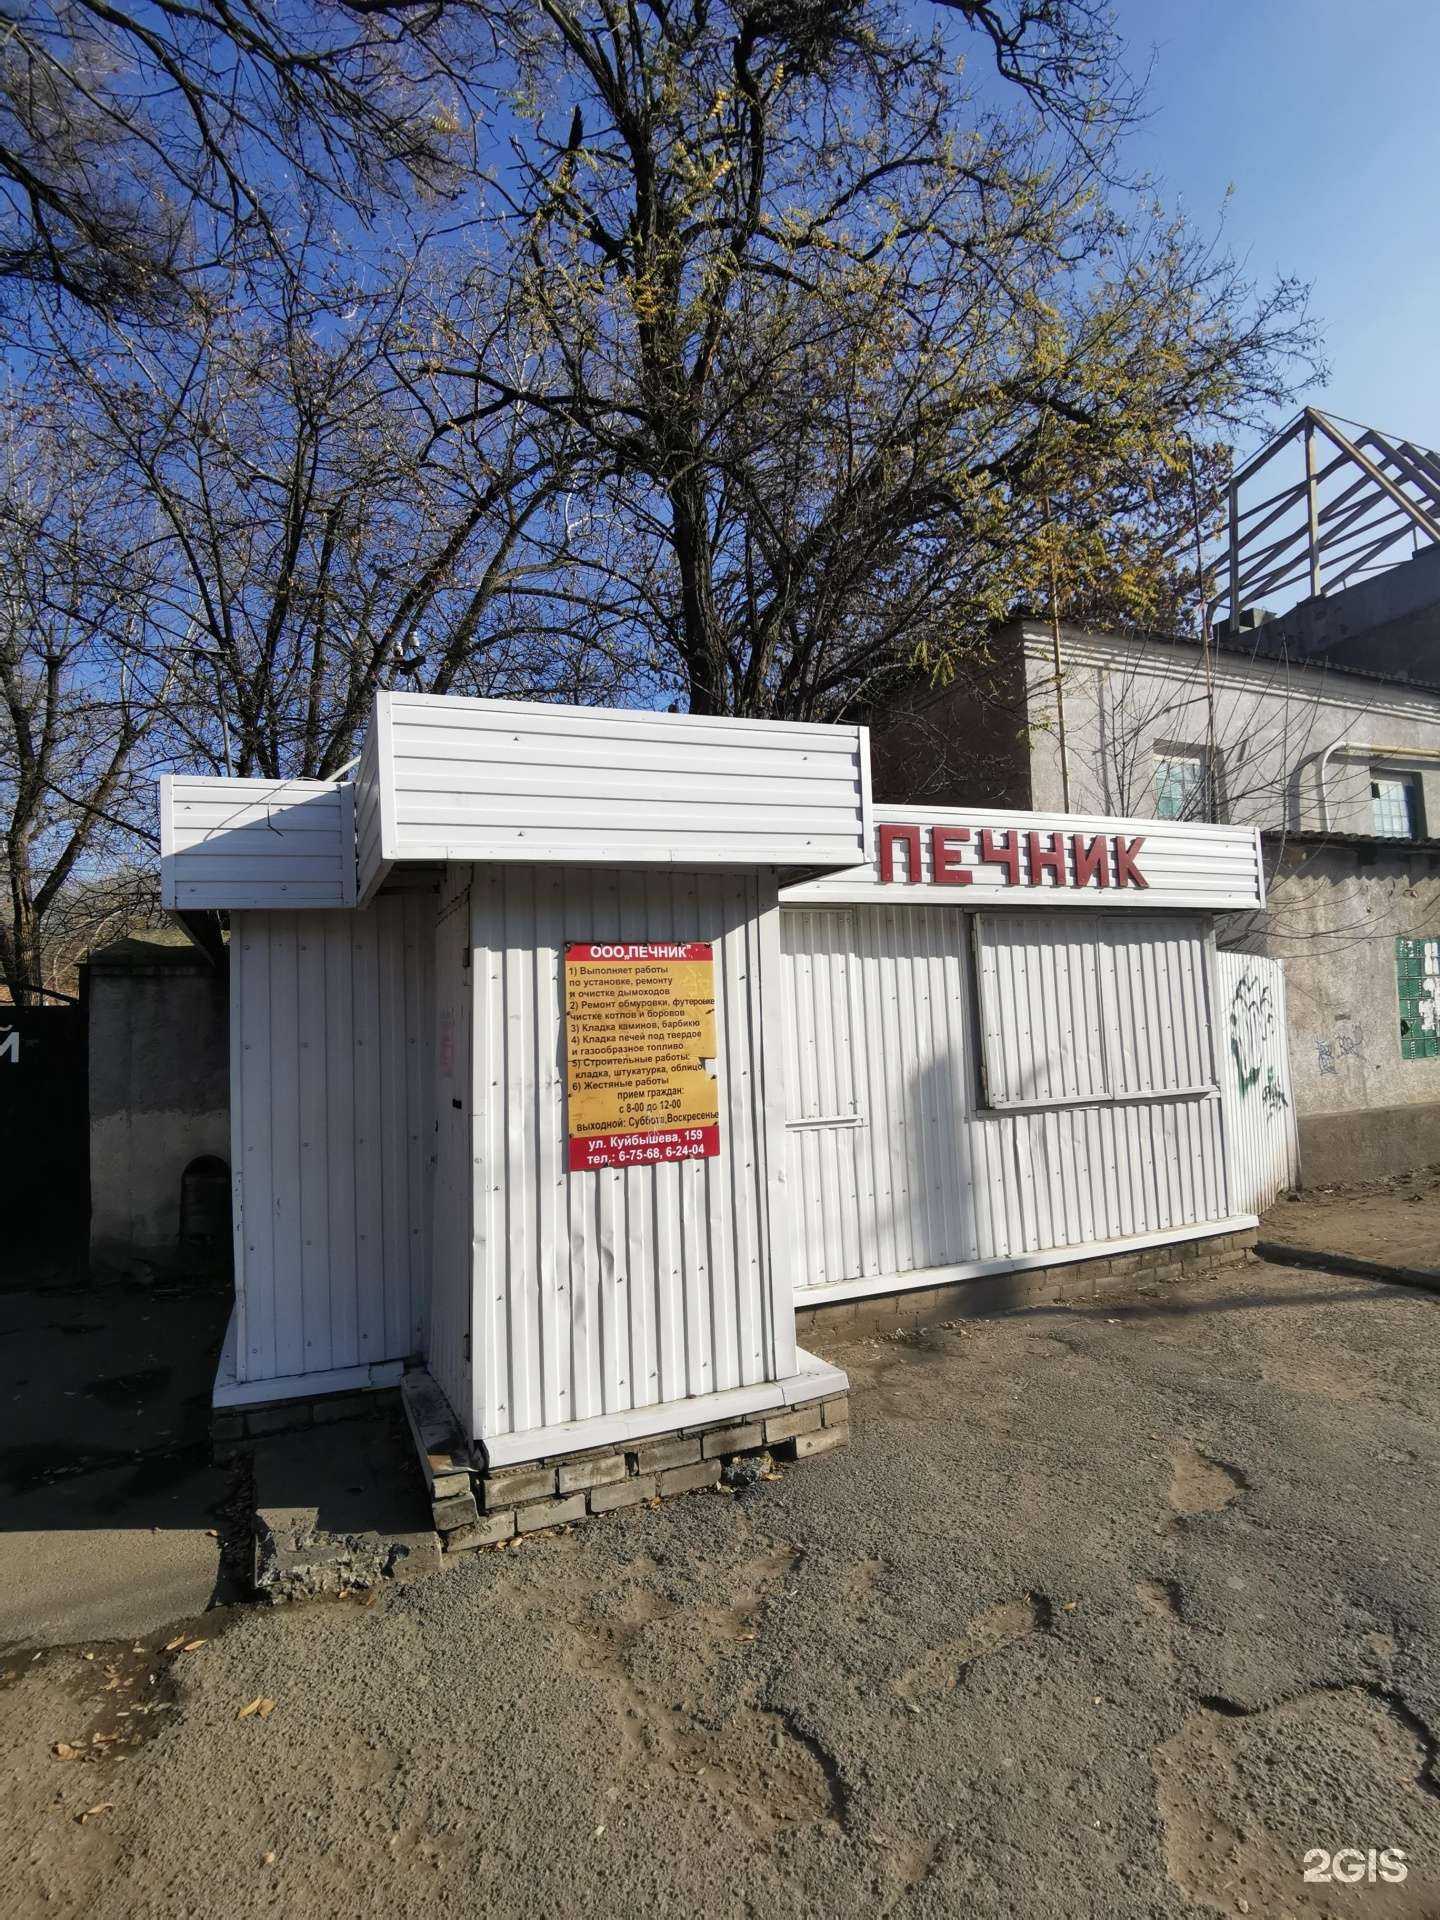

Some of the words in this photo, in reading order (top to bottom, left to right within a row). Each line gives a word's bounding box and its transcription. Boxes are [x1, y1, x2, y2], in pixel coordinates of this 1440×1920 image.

[878, 823, 1150, 889] ПЕЧНИК
[569, 967, 577, 976] 1)
[580, 967, 632, 975] Выполняет
[635, 965, 668, 976] работы
[635, 977, 673, 986] ремонту
[578, 990, 615, 998] очистке
[617, 988, 670, 998] дымоходов
[569, 1001, 579, 1010] 2)
[581, 1001, 615, 1009] Ремонт
[570, 1012, 602, 1020] чистке
[605, 1011, 637, 1019] котлов
[647, 1008, 685, 1018] боровов
[570, 1024, 580, 1033] 3)
[582, 1024, 616, 1032] Кладка
[618, 1022, 660, 1031] каминов,
[662, 1019, 700, 1029] барбикю
[571, 1035, 580, 1045] 4)
[583, 1034, 616, 1043] Кладка
[618, 1031, 645, 1041] печей
[648, 1032, 665, 1040] под
[667, 1030, 701, 1039] твердое
[580, 1043, 645, 1056] газообразное
[646, 1042, 684, 1051] топливо
[572, 1059, 580, 1069] 5)
[583, 1056, 653, 1067] Строительные
[575, 1068, 611, 1079] кладка,
[614, 1065, 669, 1077] штукатурка,
[572, 1080, 581, 1091] 6)
[583, 1079, 633, 1090] Жестяные
[635, 1076, 669, 1087] работы
[617, 1089, 645, 1101] прием
[647, 1087, 684, 1098] граждан:
[619, 1105, 624, 1113] с
[626, 1102, 645, 1113] 8-00
[646, 1103, 658, 1113] до
[660, 1100, 682, 1110] 12-00
[576, 1118, 626, 1132] выходной:
[588, 1140, 607, 1152] ул.
[610, 1134, 681, 1150] Куйбышева,
[684, 1129, 703, 1141] 159
[618, 1148, 663, 1161] 6-75-68,
[665, 1143, 705, 1157] 6-24-04
